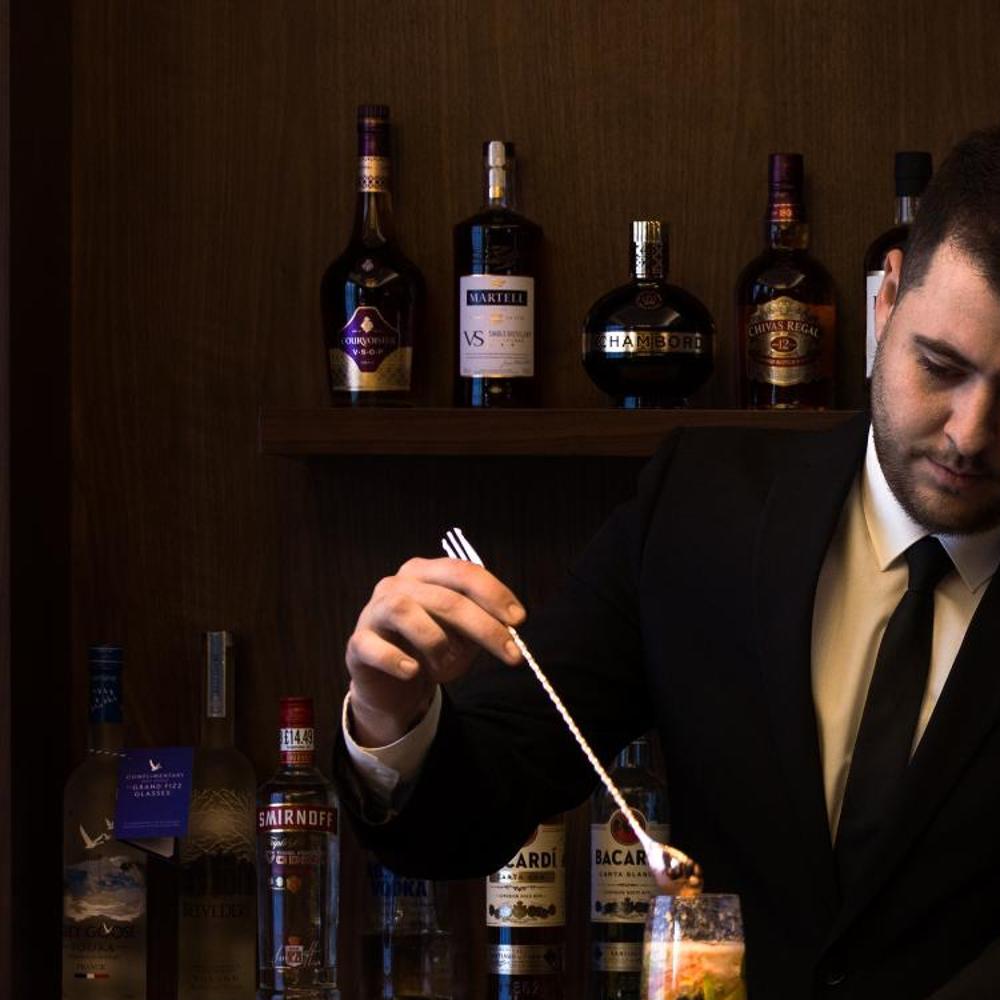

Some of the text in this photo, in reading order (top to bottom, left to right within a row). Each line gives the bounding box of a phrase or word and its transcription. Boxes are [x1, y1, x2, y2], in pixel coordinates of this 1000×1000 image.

[469, 292, 525, 304] MARTELL
[749, 321, 820, 338] CHIVAS REGAL
[464, 330, 485, 347] VS
[597, 332, 704, 350] CHAMBORD
[259, 807, 334, 828] SMIRNOFF
[596, 849, 647, 866] BACAR
